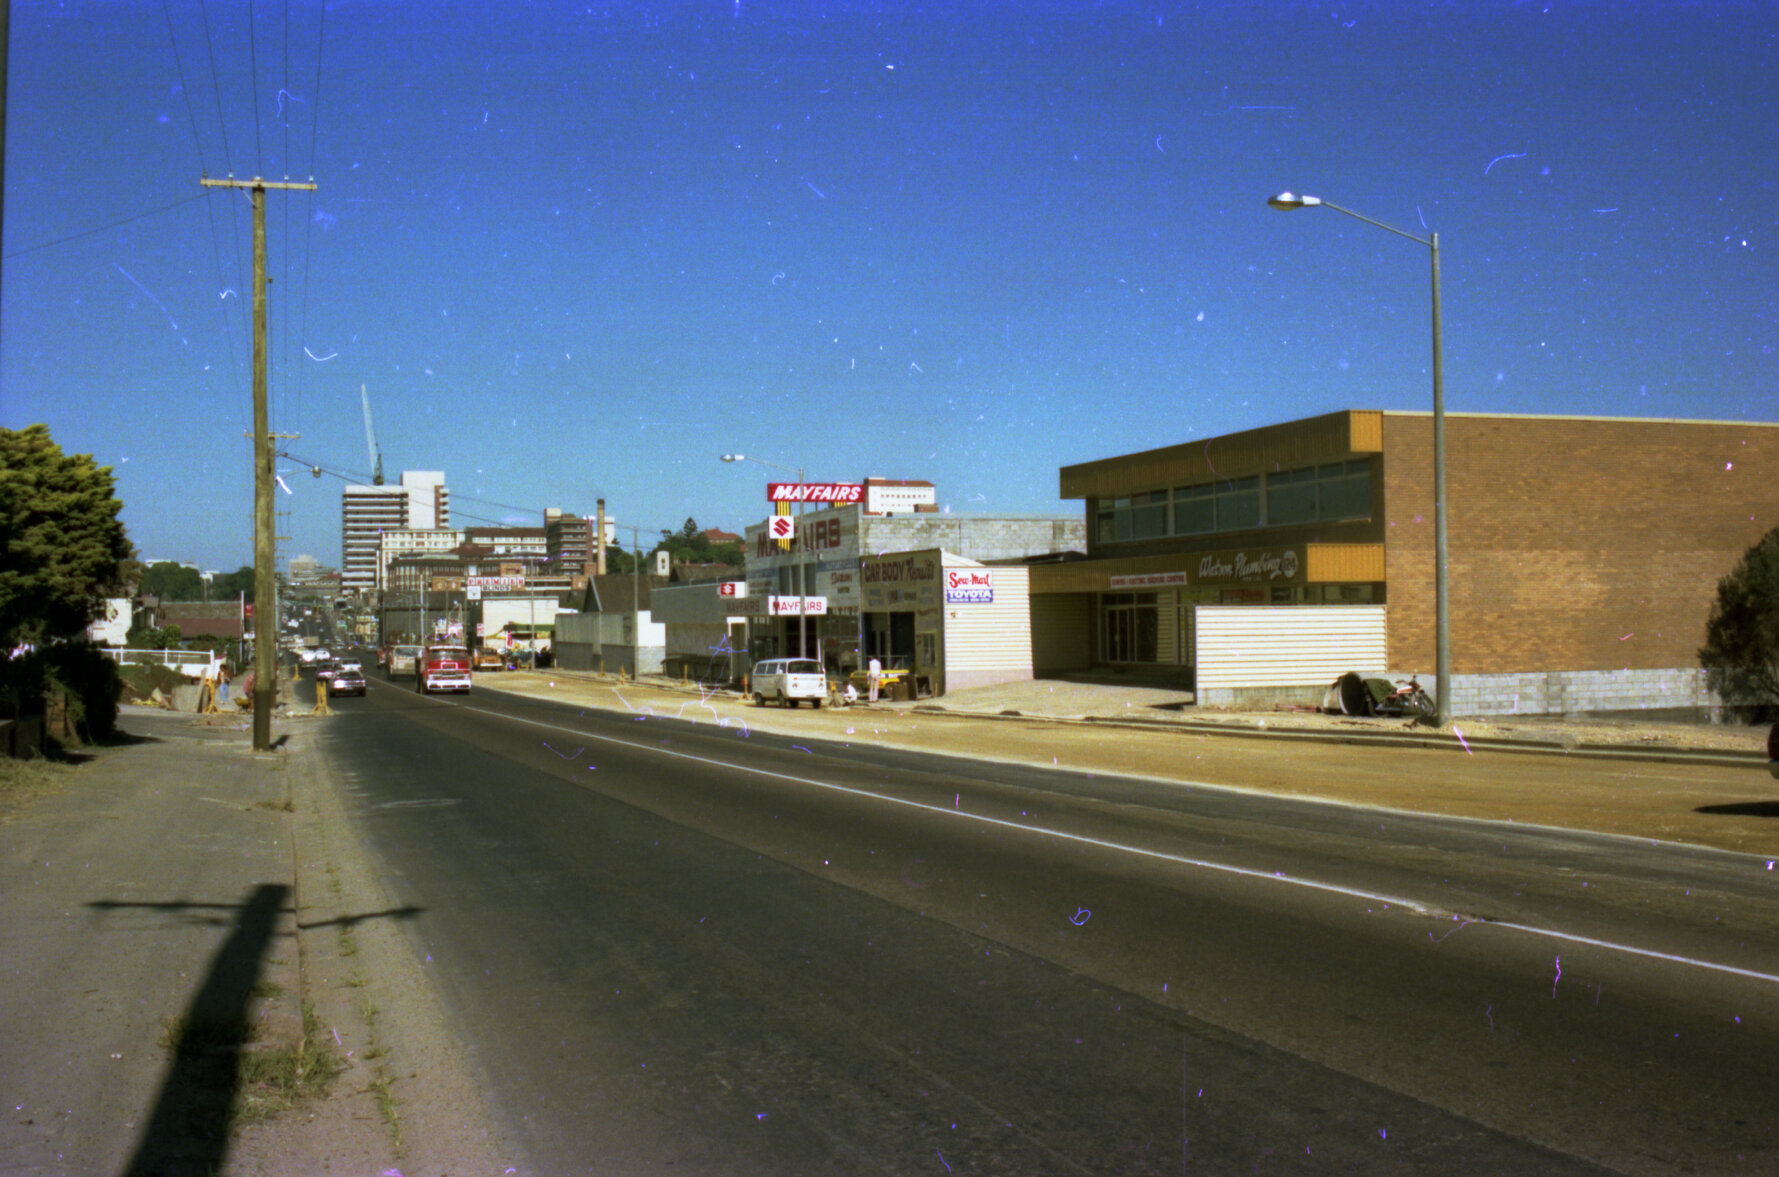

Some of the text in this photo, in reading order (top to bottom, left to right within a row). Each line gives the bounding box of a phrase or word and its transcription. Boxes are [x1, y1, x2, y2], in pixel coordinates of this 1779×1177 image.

[772, 485, 862, 500] MAYFAIRS
[865, 562, 880, 582] CAR
[882, 560, 904, 581] BODY
[948, 590, 992, 598] TOYOTA
